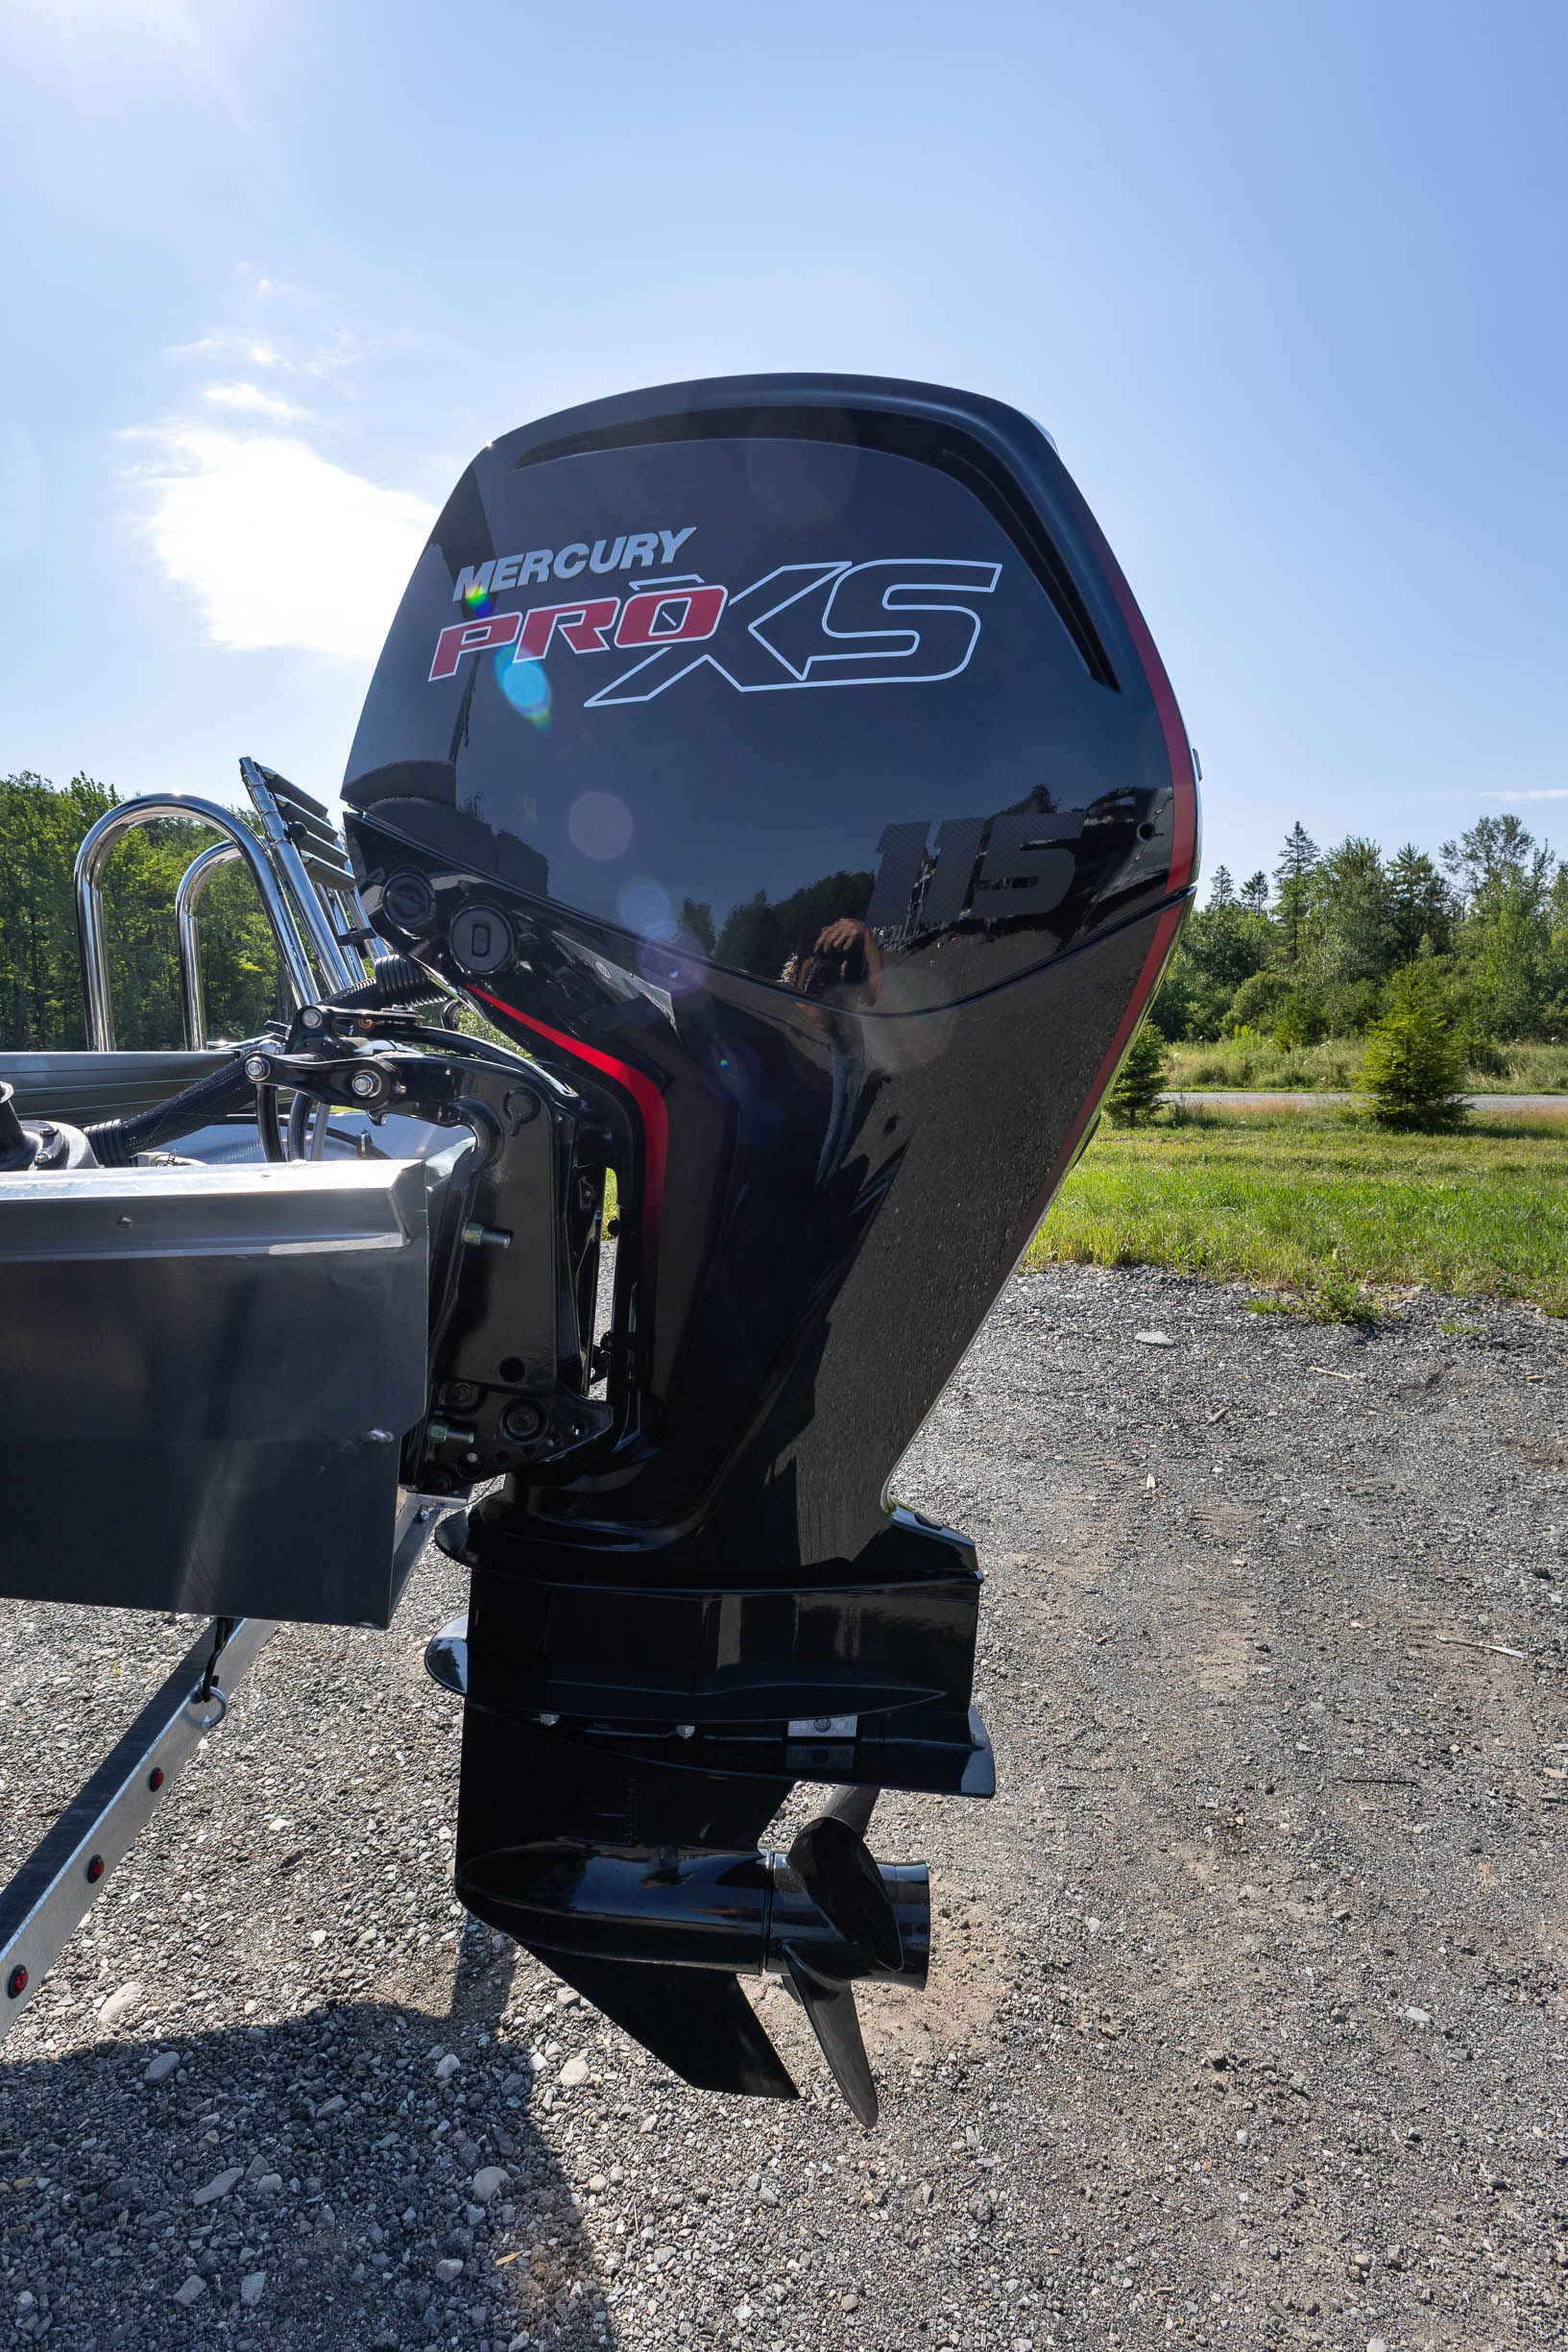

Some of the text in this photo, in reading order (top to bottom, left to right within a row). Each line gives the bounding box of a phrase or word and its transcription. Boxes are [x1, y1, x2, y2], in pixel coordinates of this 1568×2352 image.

[452, 526, 697, 603] MERCURY
[428, 558, 1003, 708] PRO XS
[866, 812, 1087, 924] 115
